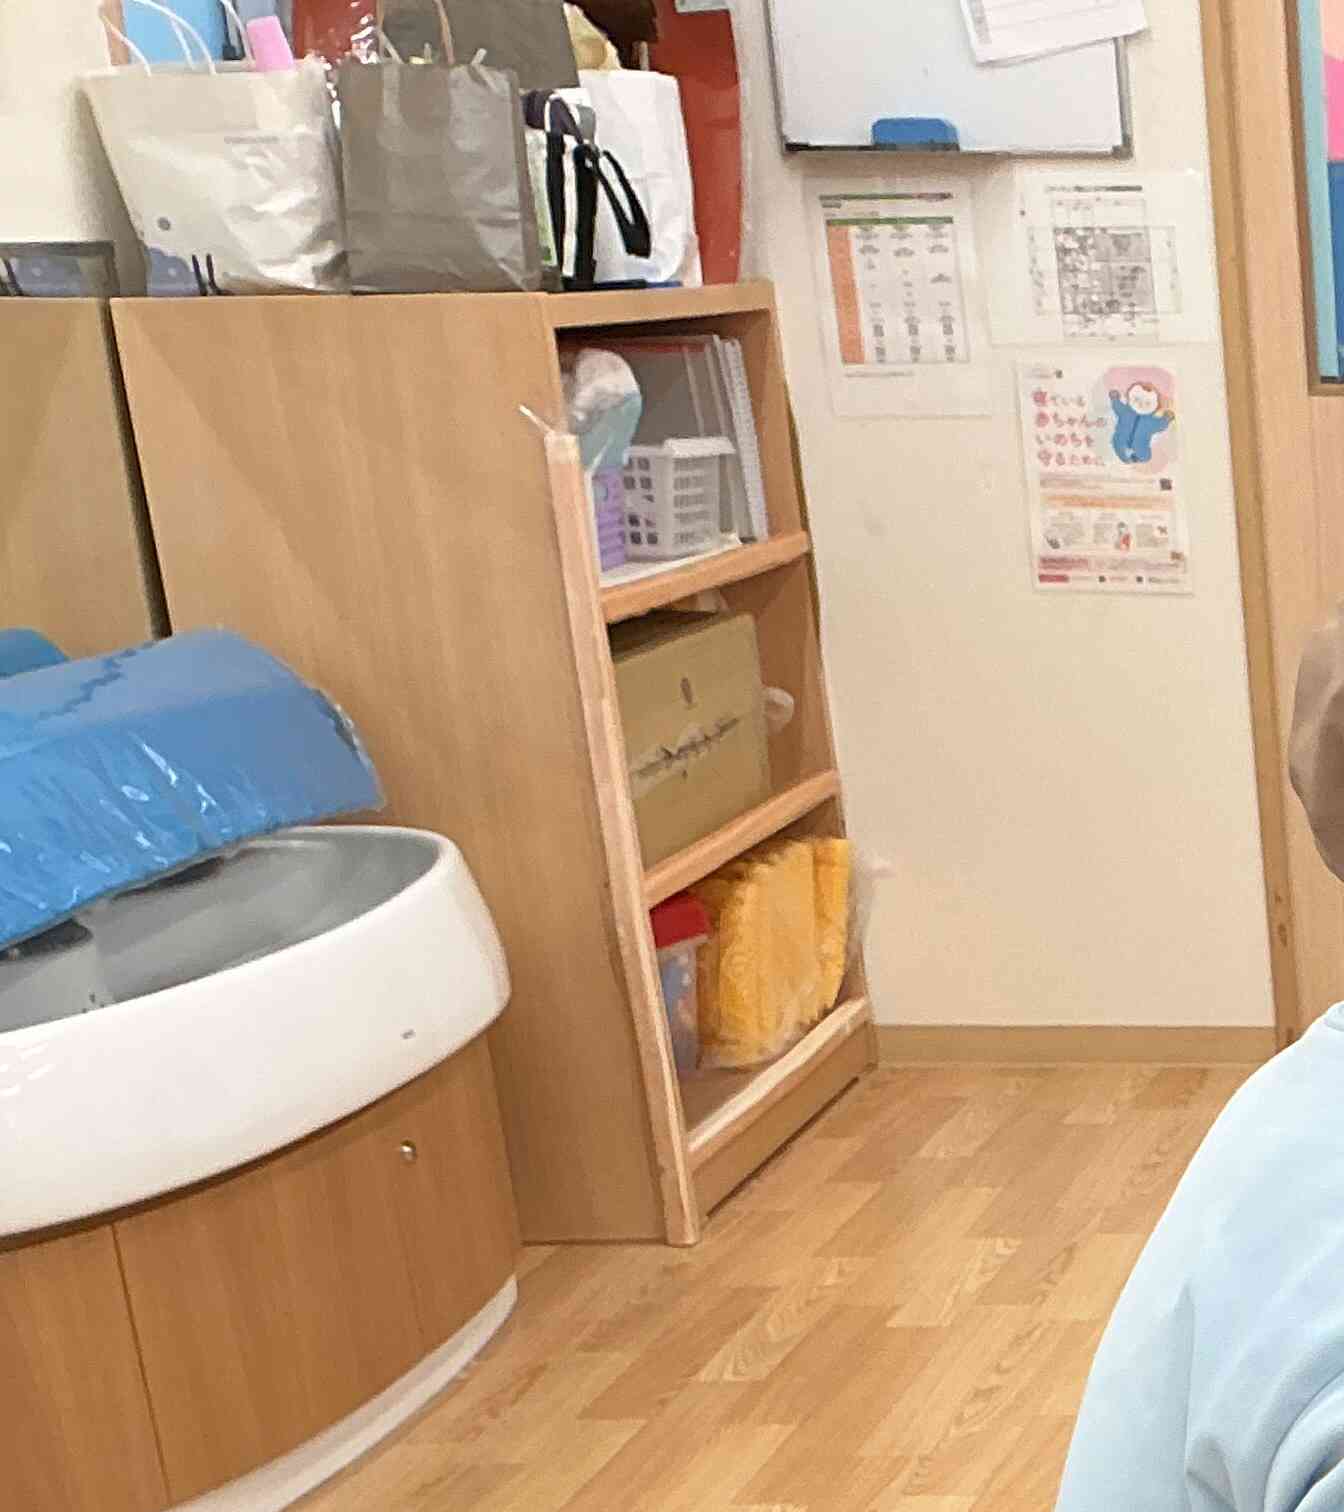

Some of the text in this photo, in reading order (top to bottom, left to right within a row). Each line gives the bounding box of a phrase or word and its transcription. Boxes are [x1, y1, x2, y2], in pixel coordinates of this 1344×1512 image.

[1034, 411, 1106, 428] 赤ちゃんの
